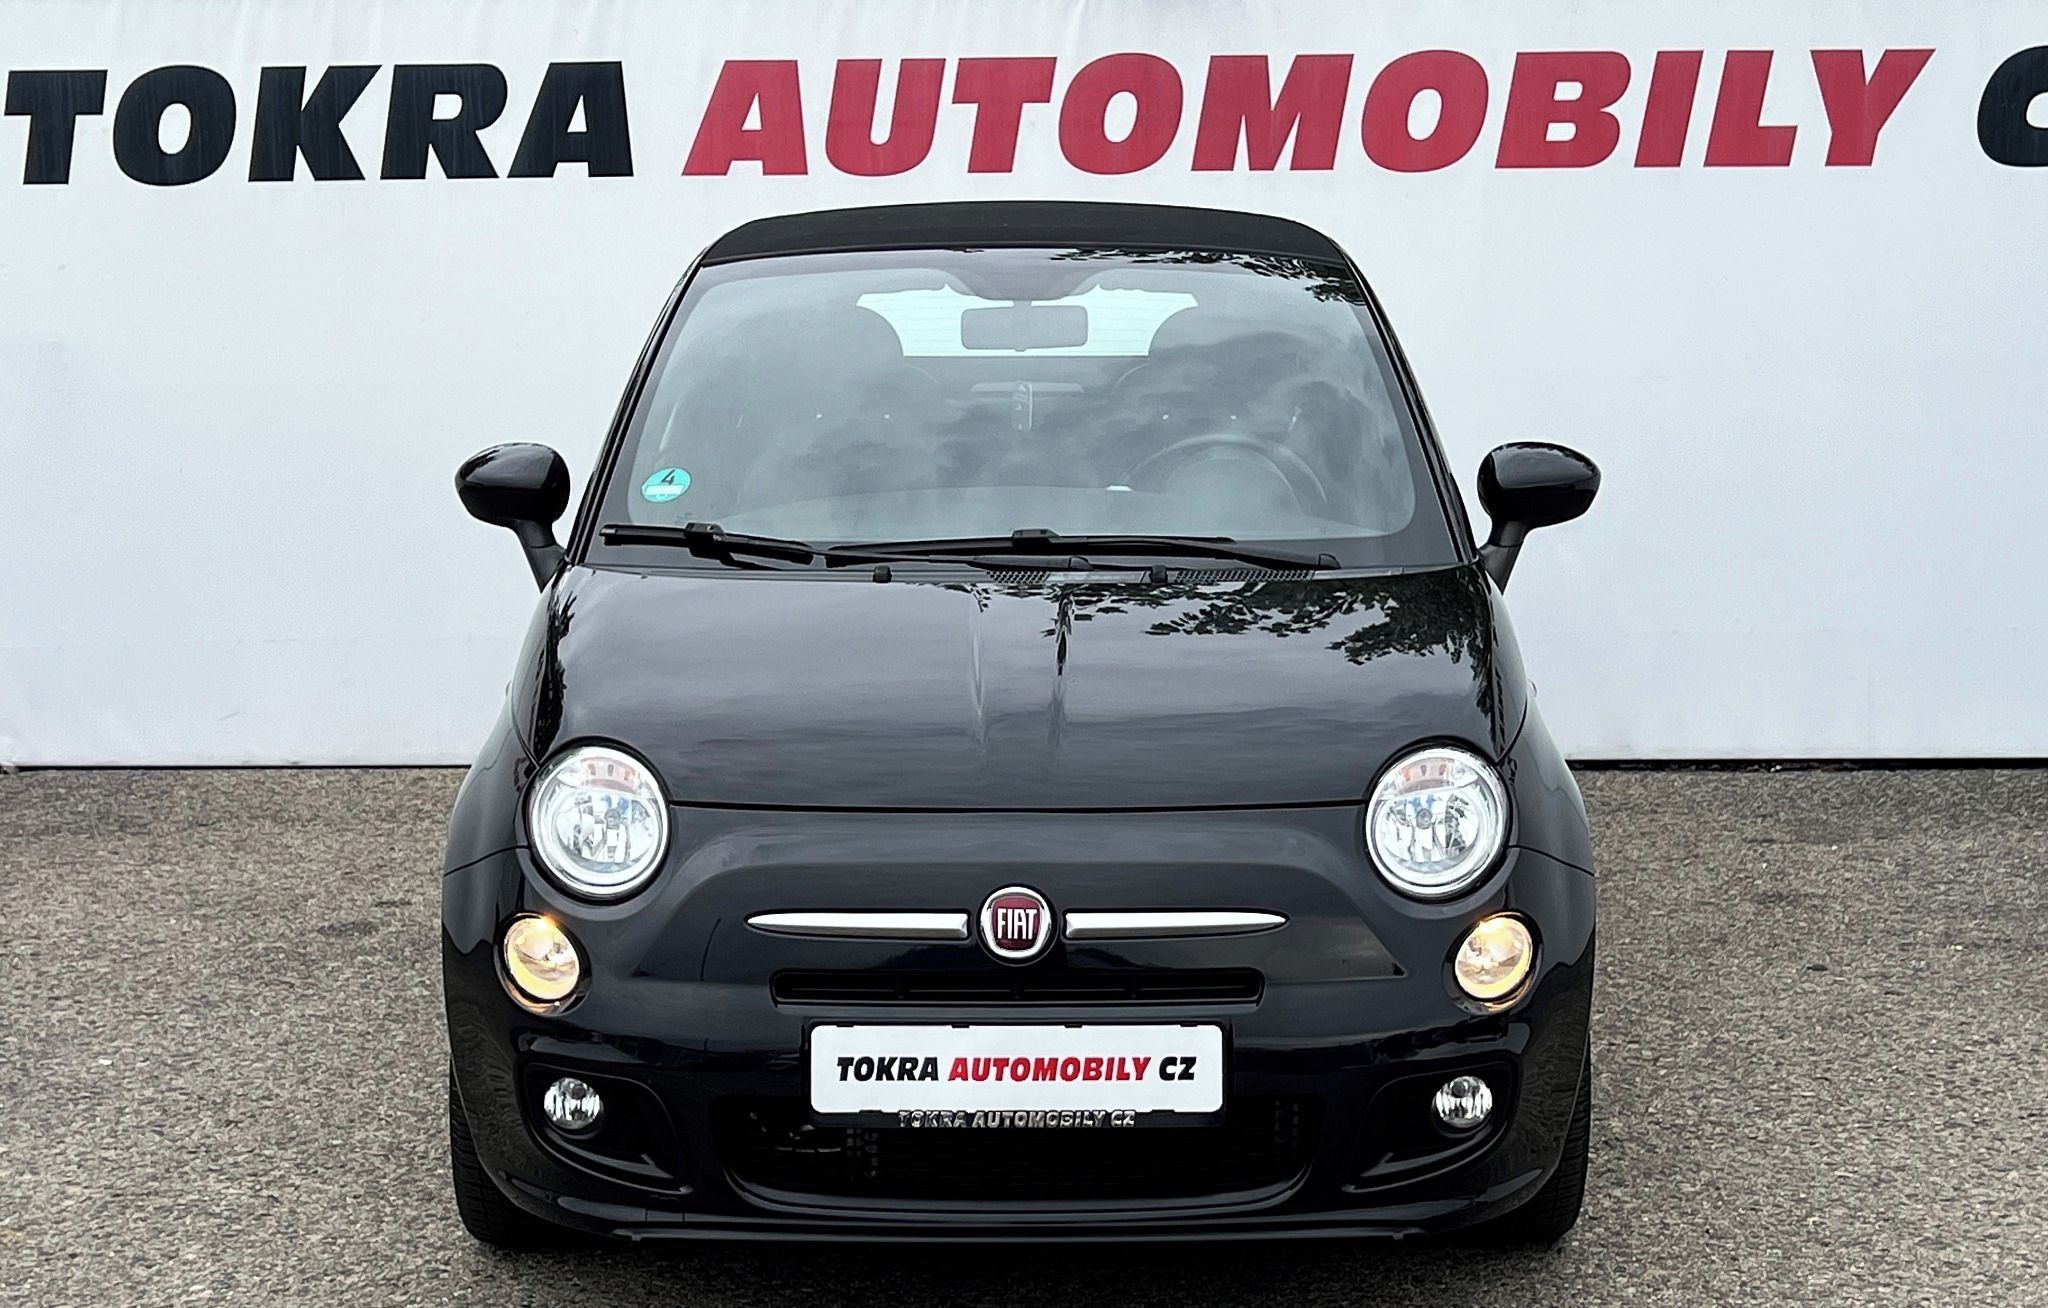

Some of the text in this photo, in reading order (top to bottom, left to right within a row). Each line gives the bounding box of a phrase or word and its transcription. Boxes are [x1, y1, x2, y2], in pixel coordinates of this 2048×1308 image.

[4, 61, 634, 187] TOKRA
[681, 48, 1937, 177] AUTOMOBILY
[661, 468, 677, 486] 4
[997, 908, 1037, 940] FIAT
[837, 1056, 1197, 1082] TOKRA AUTOMOBILY CZ
[898, 1110, 1136, 1128] TOKRA AUTOMOBILY CZ
